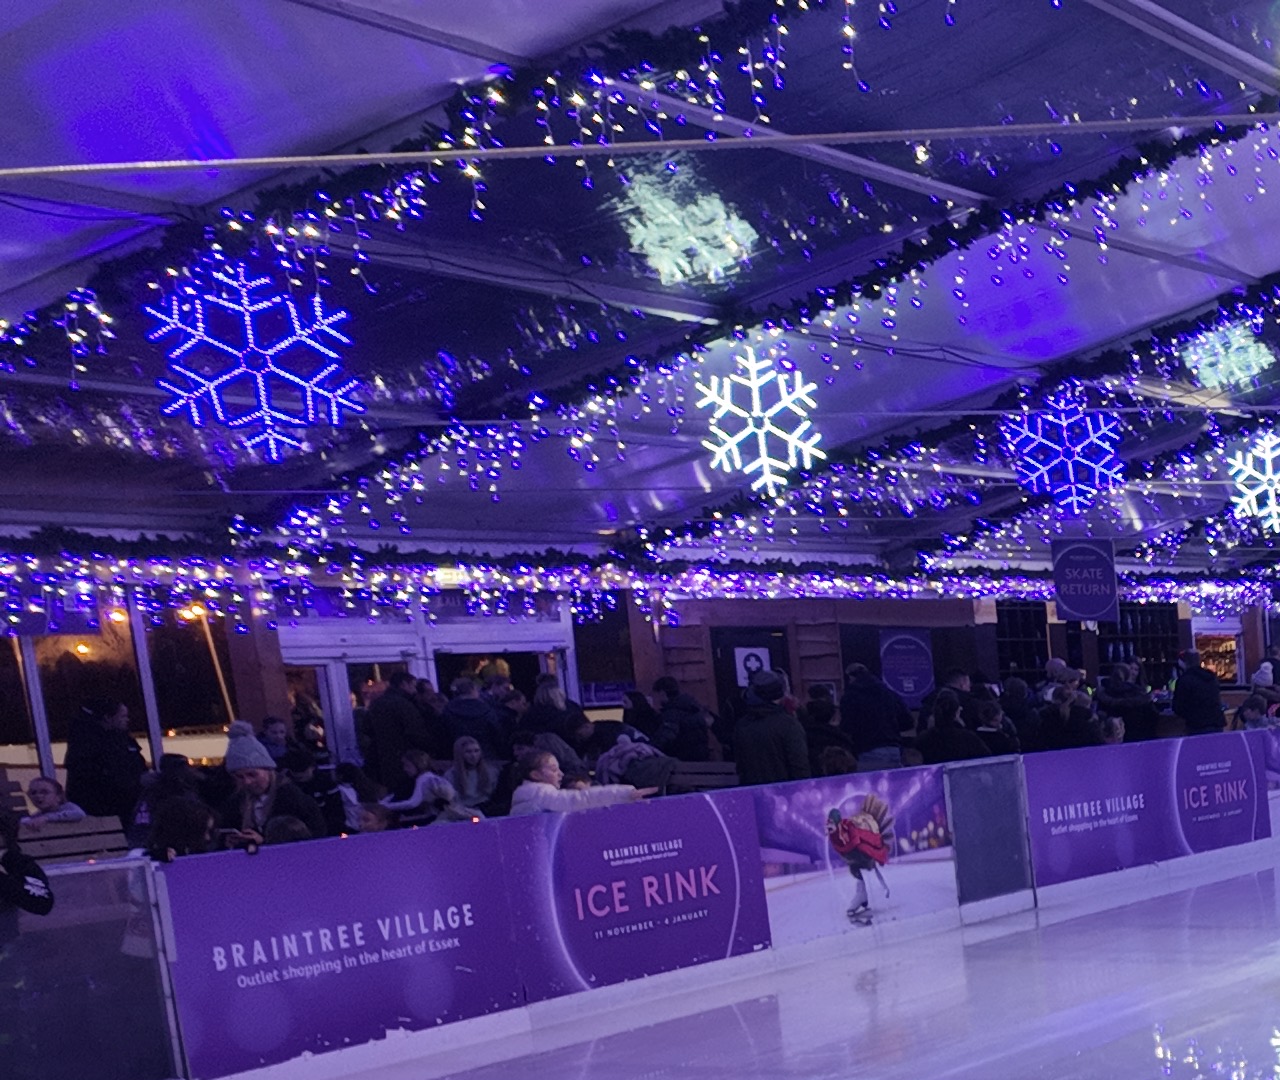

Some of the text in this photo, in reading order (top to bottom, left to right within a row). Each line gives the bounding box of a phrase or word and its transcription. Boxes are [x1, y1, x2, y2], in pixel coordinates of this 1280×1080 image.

[1065, 568, 1103, 580] SKATE
[1061, 584, 1110, 596] RETURN
[1042, 793, 1145, 824] BRAINTREE VILLAGE
[1183, 779, 1248, 810] ICE RINK
[651, 838, 683, 852] VILLAGE
[574, 864, 721, 922] ICE RINK
[212, 903, 475, 972] BRAINTREE VILLAGE
[607, 919, 654, 937] NOVEMBER
[672, 908, 709, 924] JANUARY
[237, 938, 460, 988] Outlet shopping in the heart of Essex
